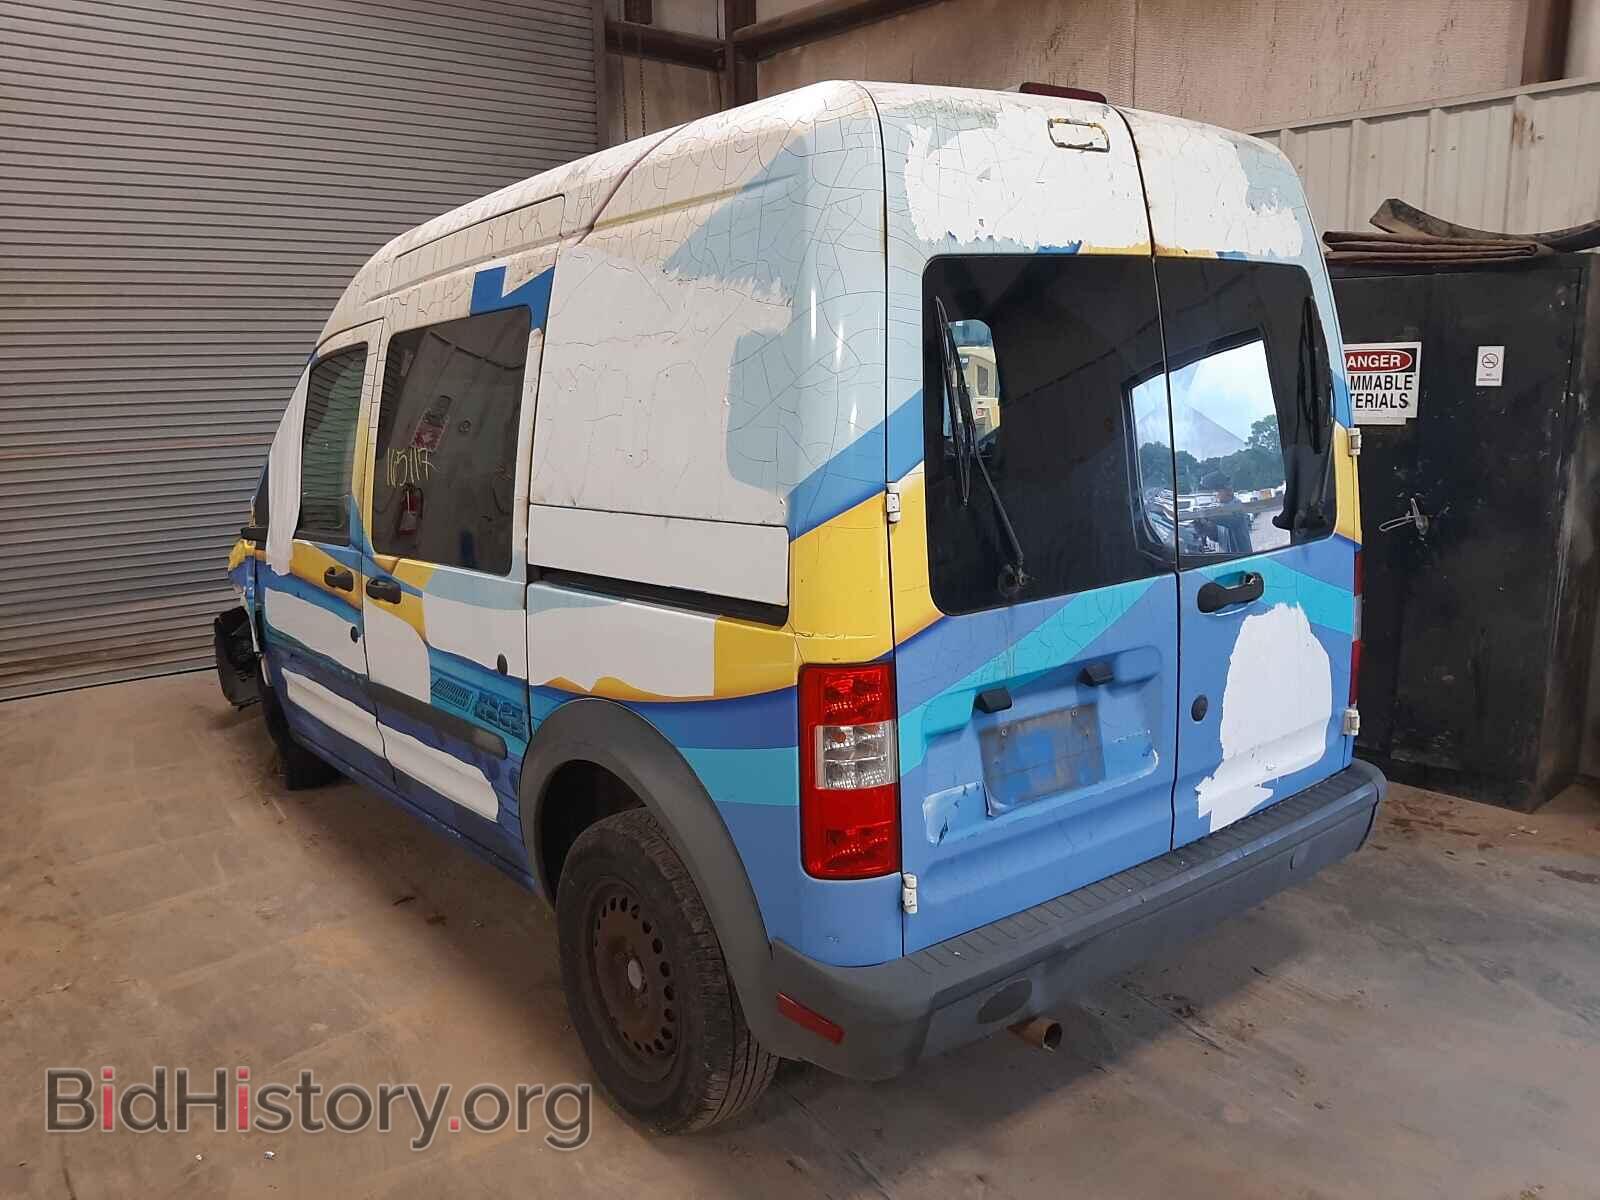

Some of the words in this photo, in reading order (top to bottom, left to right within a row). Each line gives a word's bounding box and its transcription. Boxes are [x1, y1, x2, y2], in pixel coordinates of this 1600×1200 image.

[1344, 354, 1401, 368] ANGER
[1350, 374, 1413, 391] MMABLE
[1350, 393, 1409, 409] TERIALS
